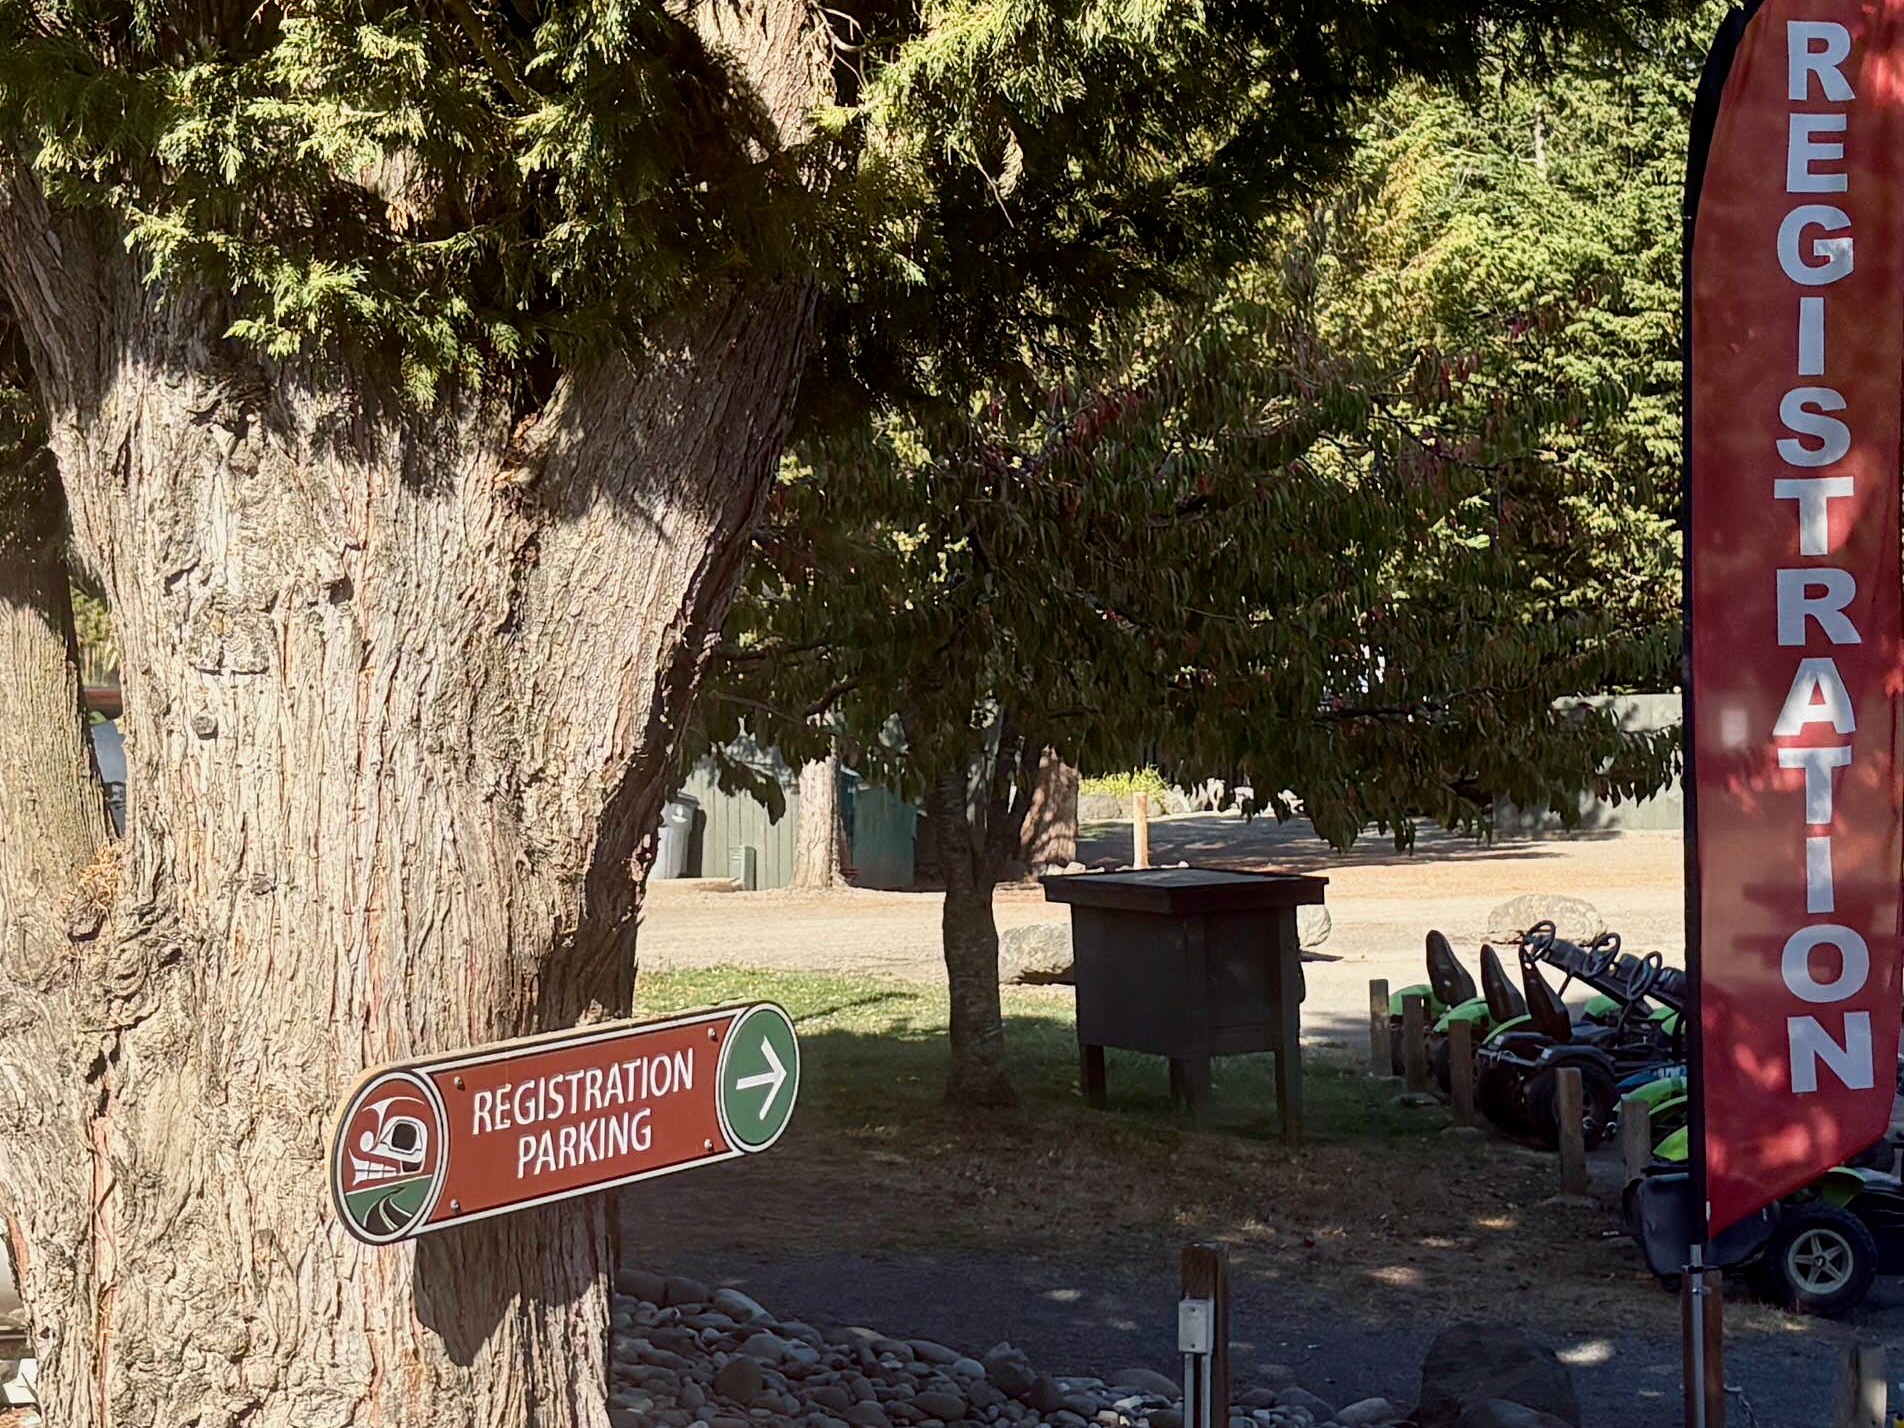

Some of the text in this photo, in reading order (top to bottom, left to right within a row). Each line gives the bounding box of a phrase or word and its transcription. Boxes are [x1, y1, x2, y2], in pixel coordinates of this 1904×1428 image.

[1772, 20, 1875, 1093] REGISTRATION
[472, 1047, 694, 1135] REGISTRATION
[517, 1107, 652, 1179] PARKING
